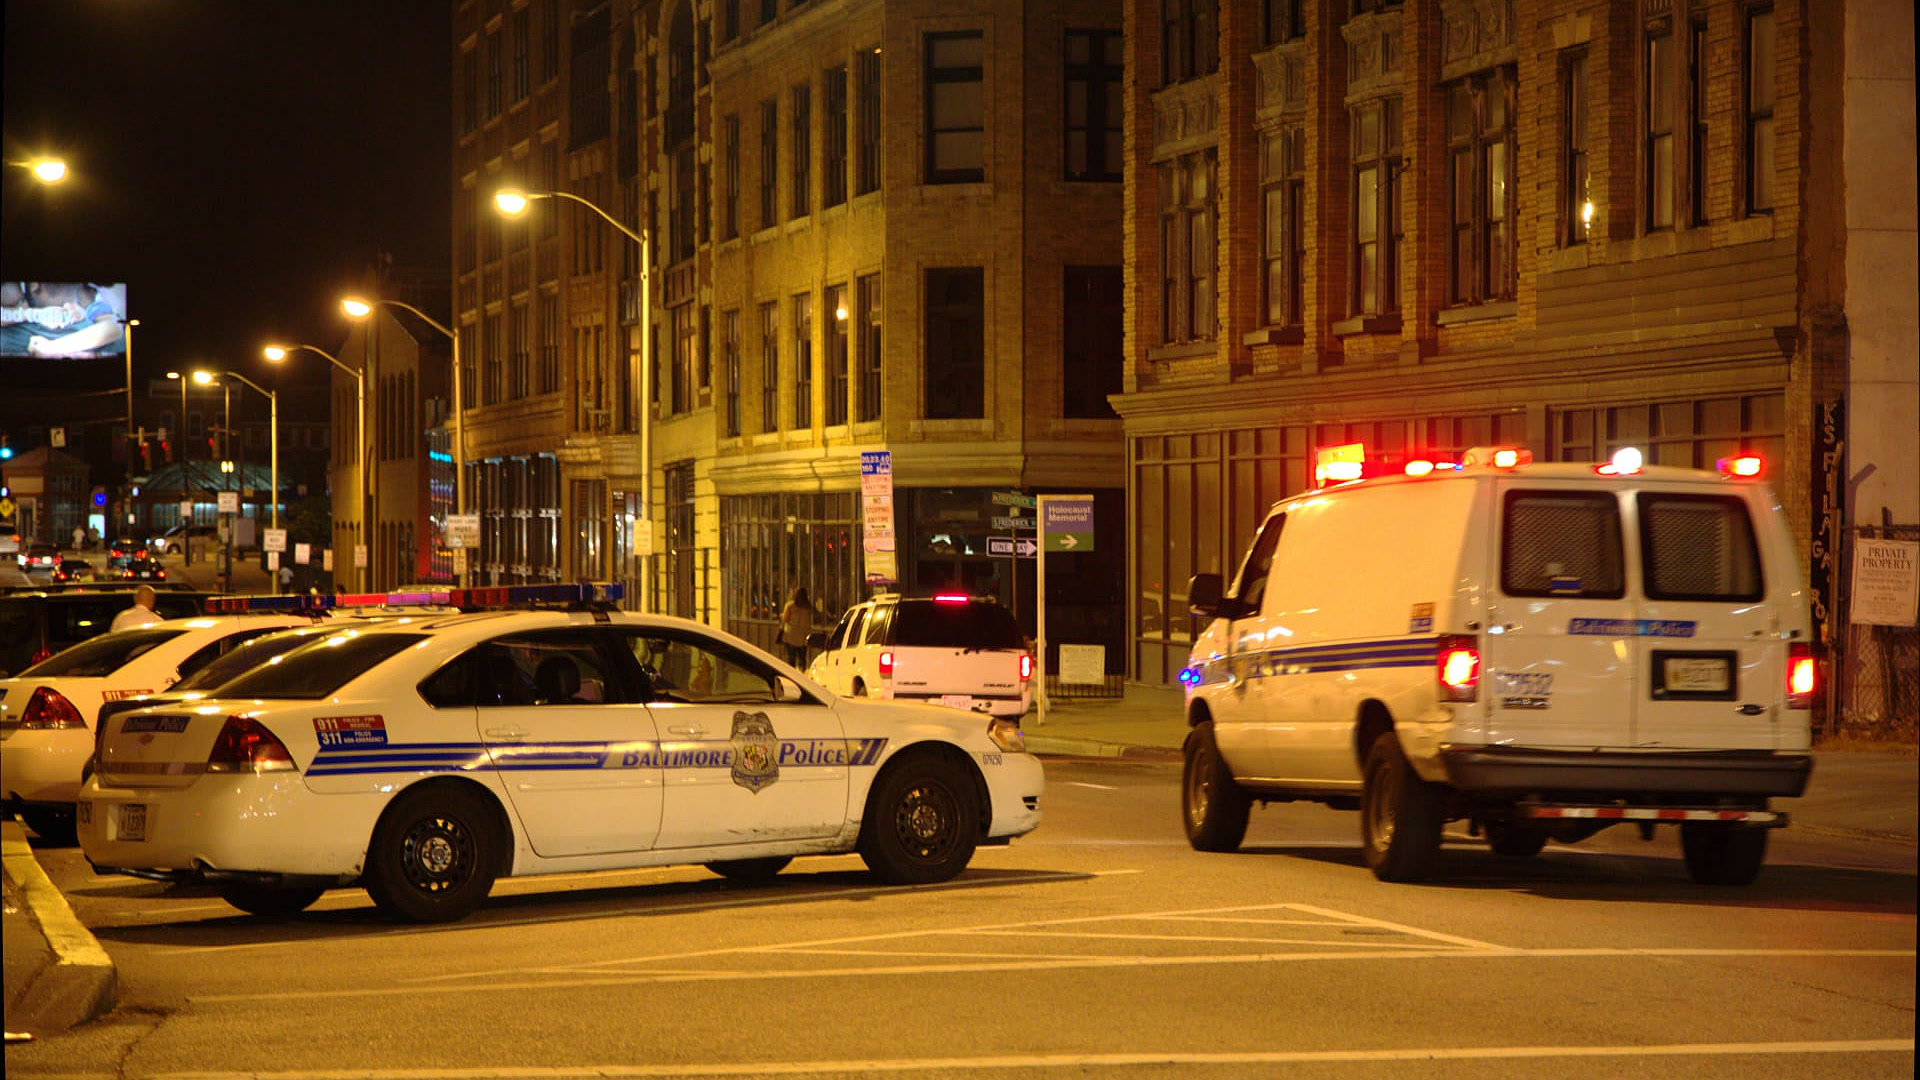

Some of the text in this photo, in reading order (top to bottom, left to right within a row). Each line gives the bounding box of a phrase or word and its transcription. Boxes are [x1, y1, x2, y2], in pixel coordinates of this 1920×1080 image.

[1048, 506, 1092, 515] Holocaust
[1048, 514, 1088, 522] Memorial
[993, 543, 1009, 552] ONE
[1868, 547, 1906, 559] PRIVATE
[1862, 558, 1912, 570] PROPERTY
[317, 718, 339, 731] 911
[321, 731, 343, 745] 311
[778, 740, 847, 764] Police
